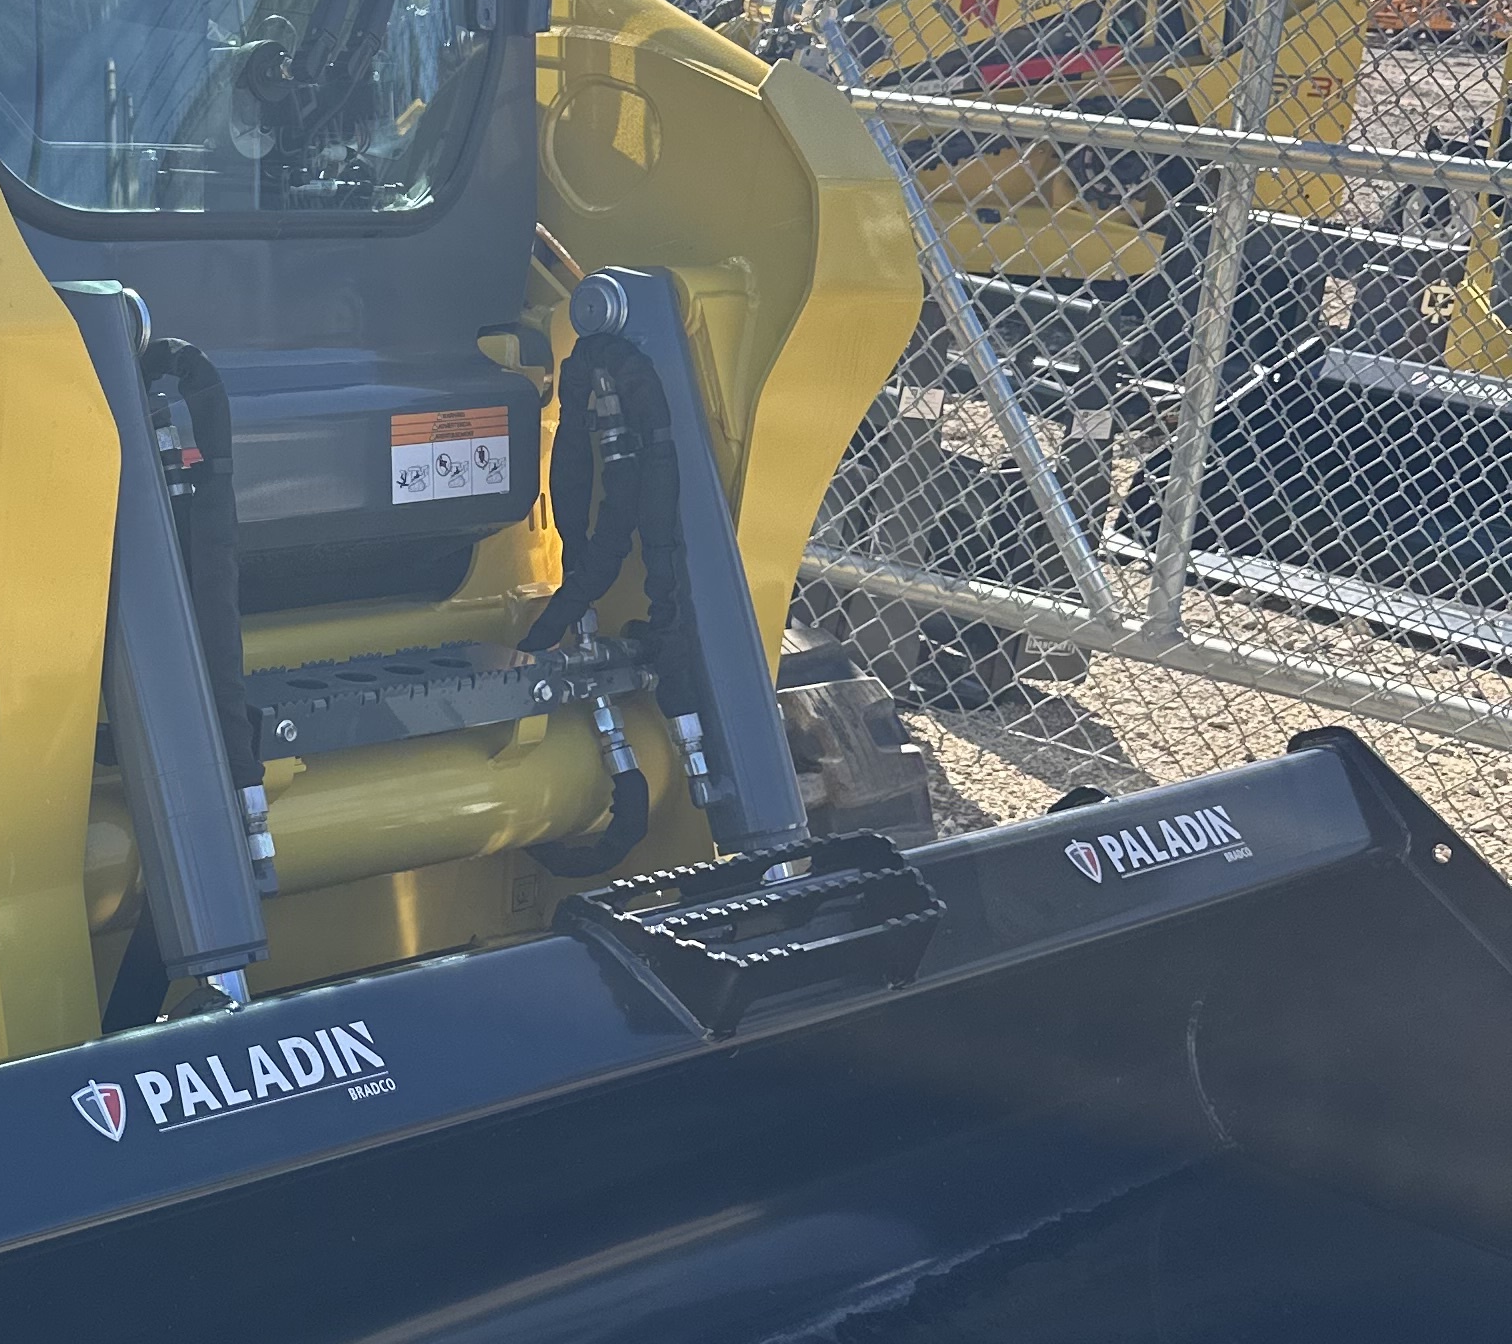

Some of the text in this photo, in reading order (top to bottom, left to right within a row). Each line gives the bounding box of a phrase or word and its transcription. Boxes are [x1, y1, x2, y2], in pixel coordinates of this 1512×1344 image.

[1096, 805, 1243, 873] PALADIN
[1223, 846, 1254, 863] BRADCO
[134, 1020, 385, 1124] PALADIN
[346, 1077, 397, 1102] BRADCO
